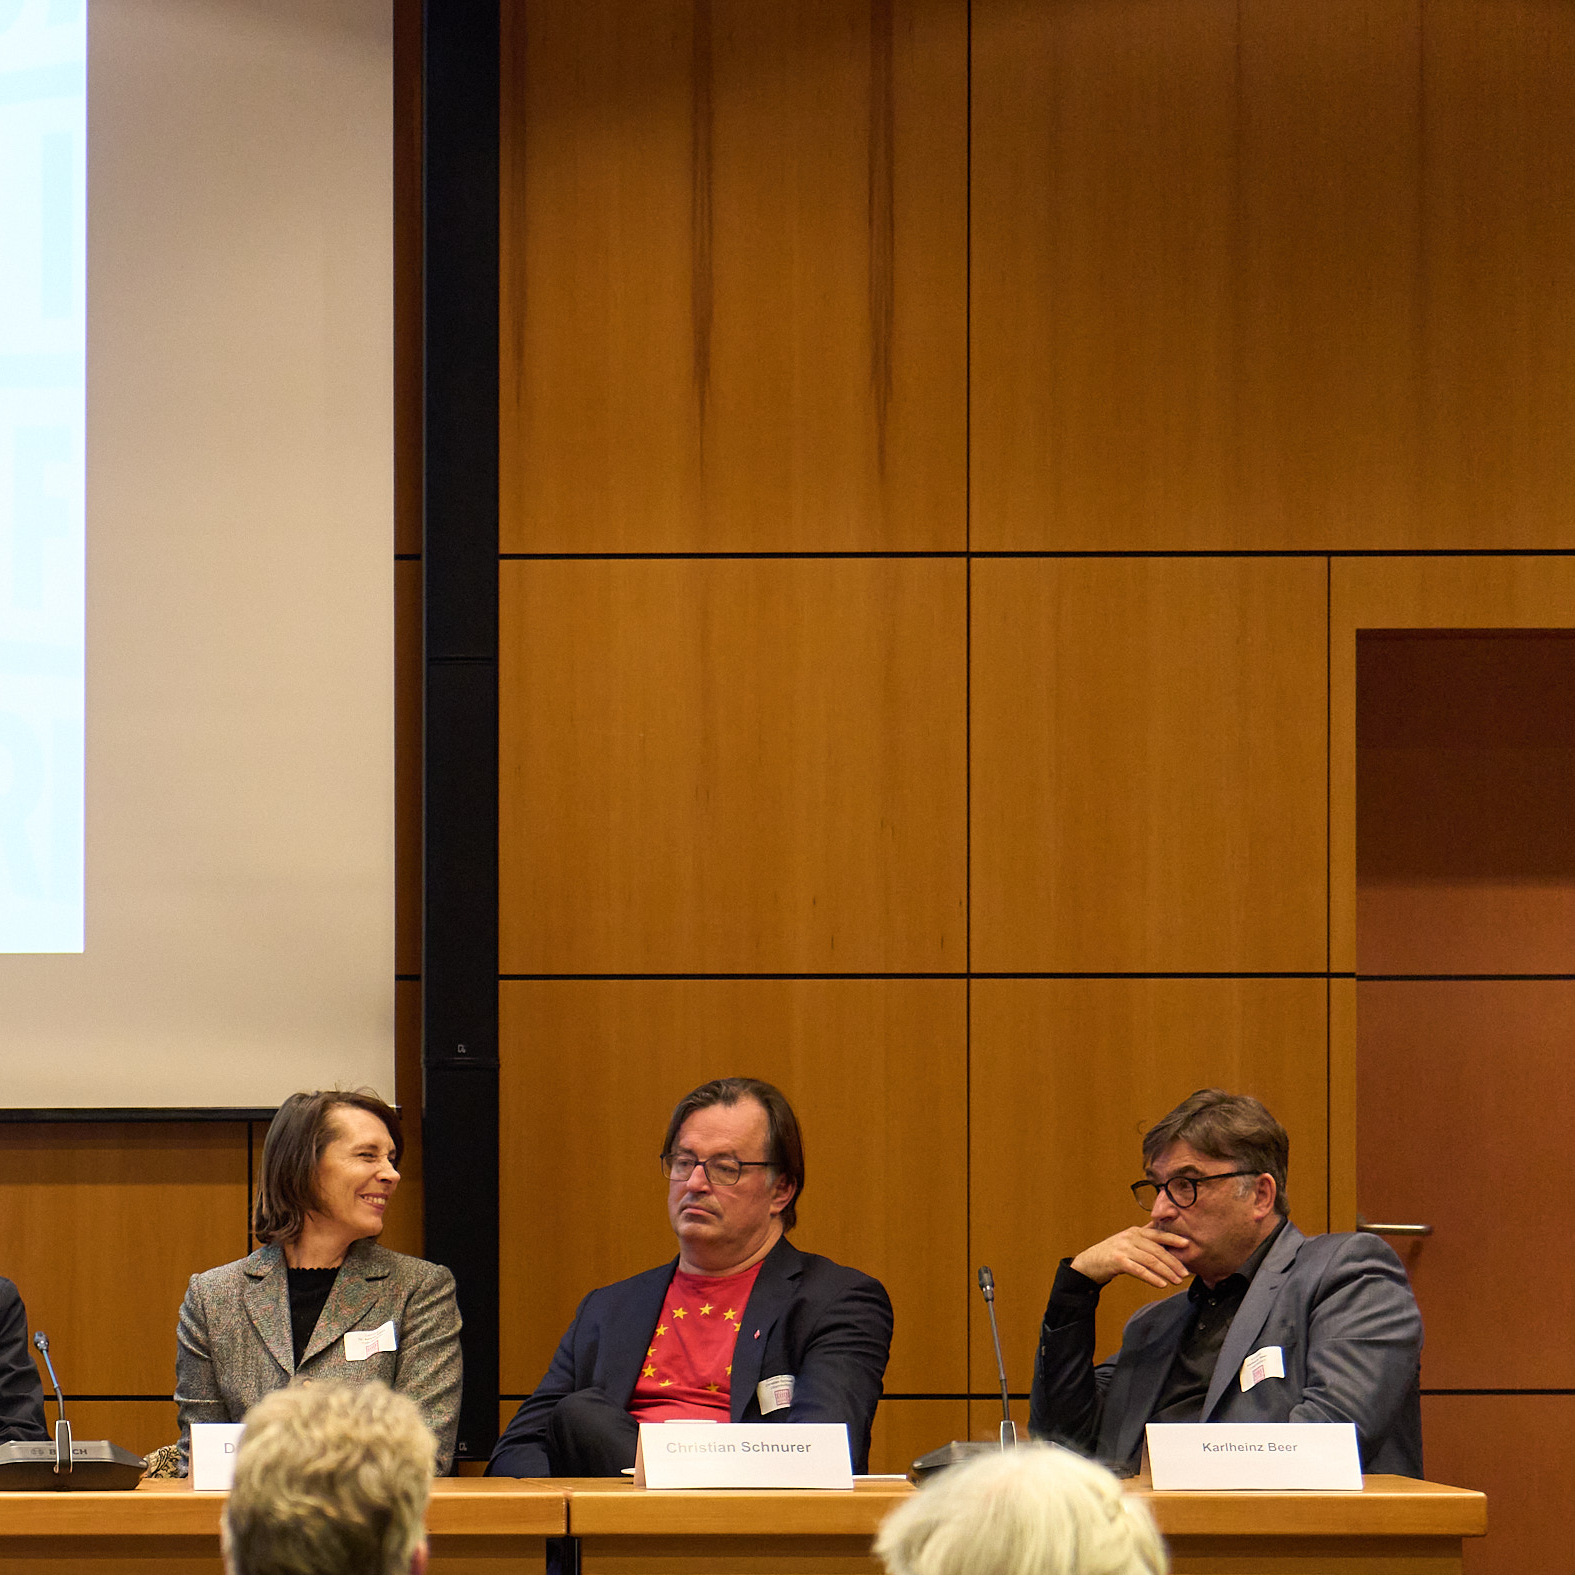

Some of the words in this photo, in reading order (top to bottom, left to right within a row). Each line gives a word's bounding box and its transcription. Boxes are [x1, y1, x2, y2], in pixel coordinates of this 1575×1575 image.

[666, 1441, 736, 1454] Christian
[740, 1441, 812, 1453] Schnurer
[1202, 1442, 1264, 1452] Karlheinz
[1267, 1442, 1299, 1452] Beer
